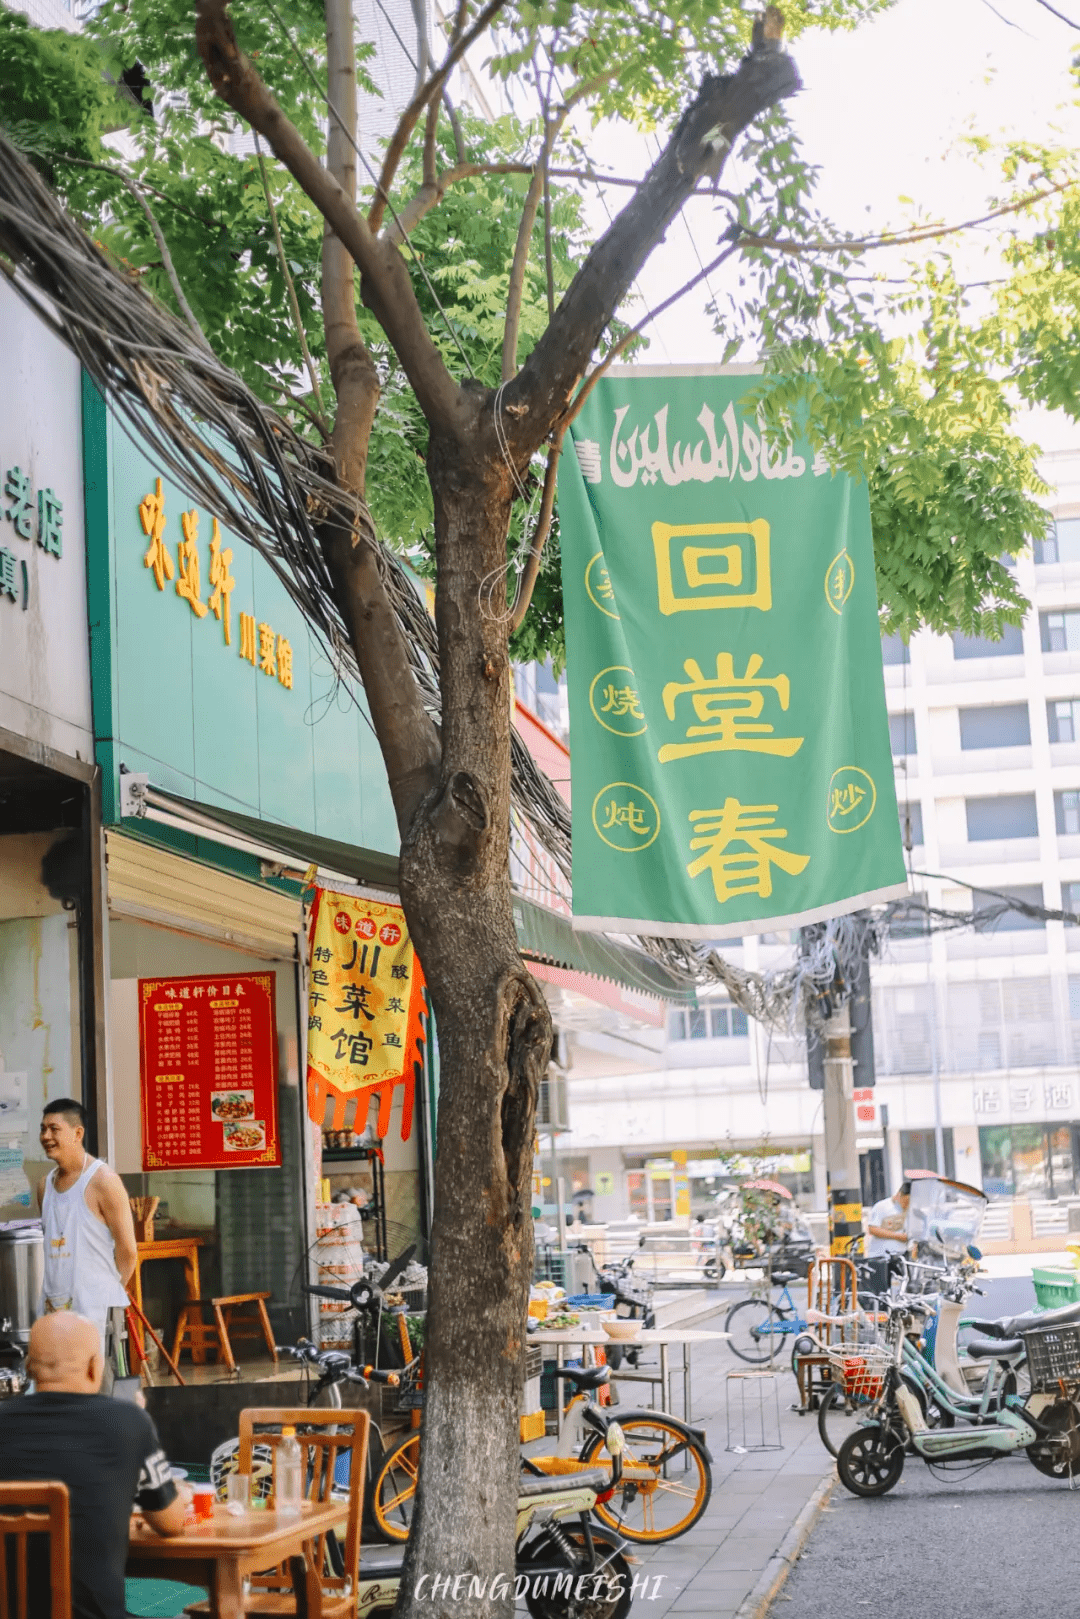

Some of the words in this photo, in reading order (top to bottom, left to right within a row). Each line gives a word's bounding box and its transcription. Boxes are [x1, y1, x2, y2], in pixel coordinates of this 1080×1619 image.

[5, 466, 63, 560] 老店
[601, 684, 645, 719] 烧
[651, 518, 810, 903] 回堂春
[602, 800, 650, 835] 炖
[830, 784, 866, 818] 炒
[335, 914, 400, 943] 味道轩
[165, 982, 247, 1000] 味道轩价目表
[307, 946, 334, 1032] 特色干锅
[330, 940, 382, 1066] 川菜馆
[381, 963, 410, 1049] 酸菜鱼
